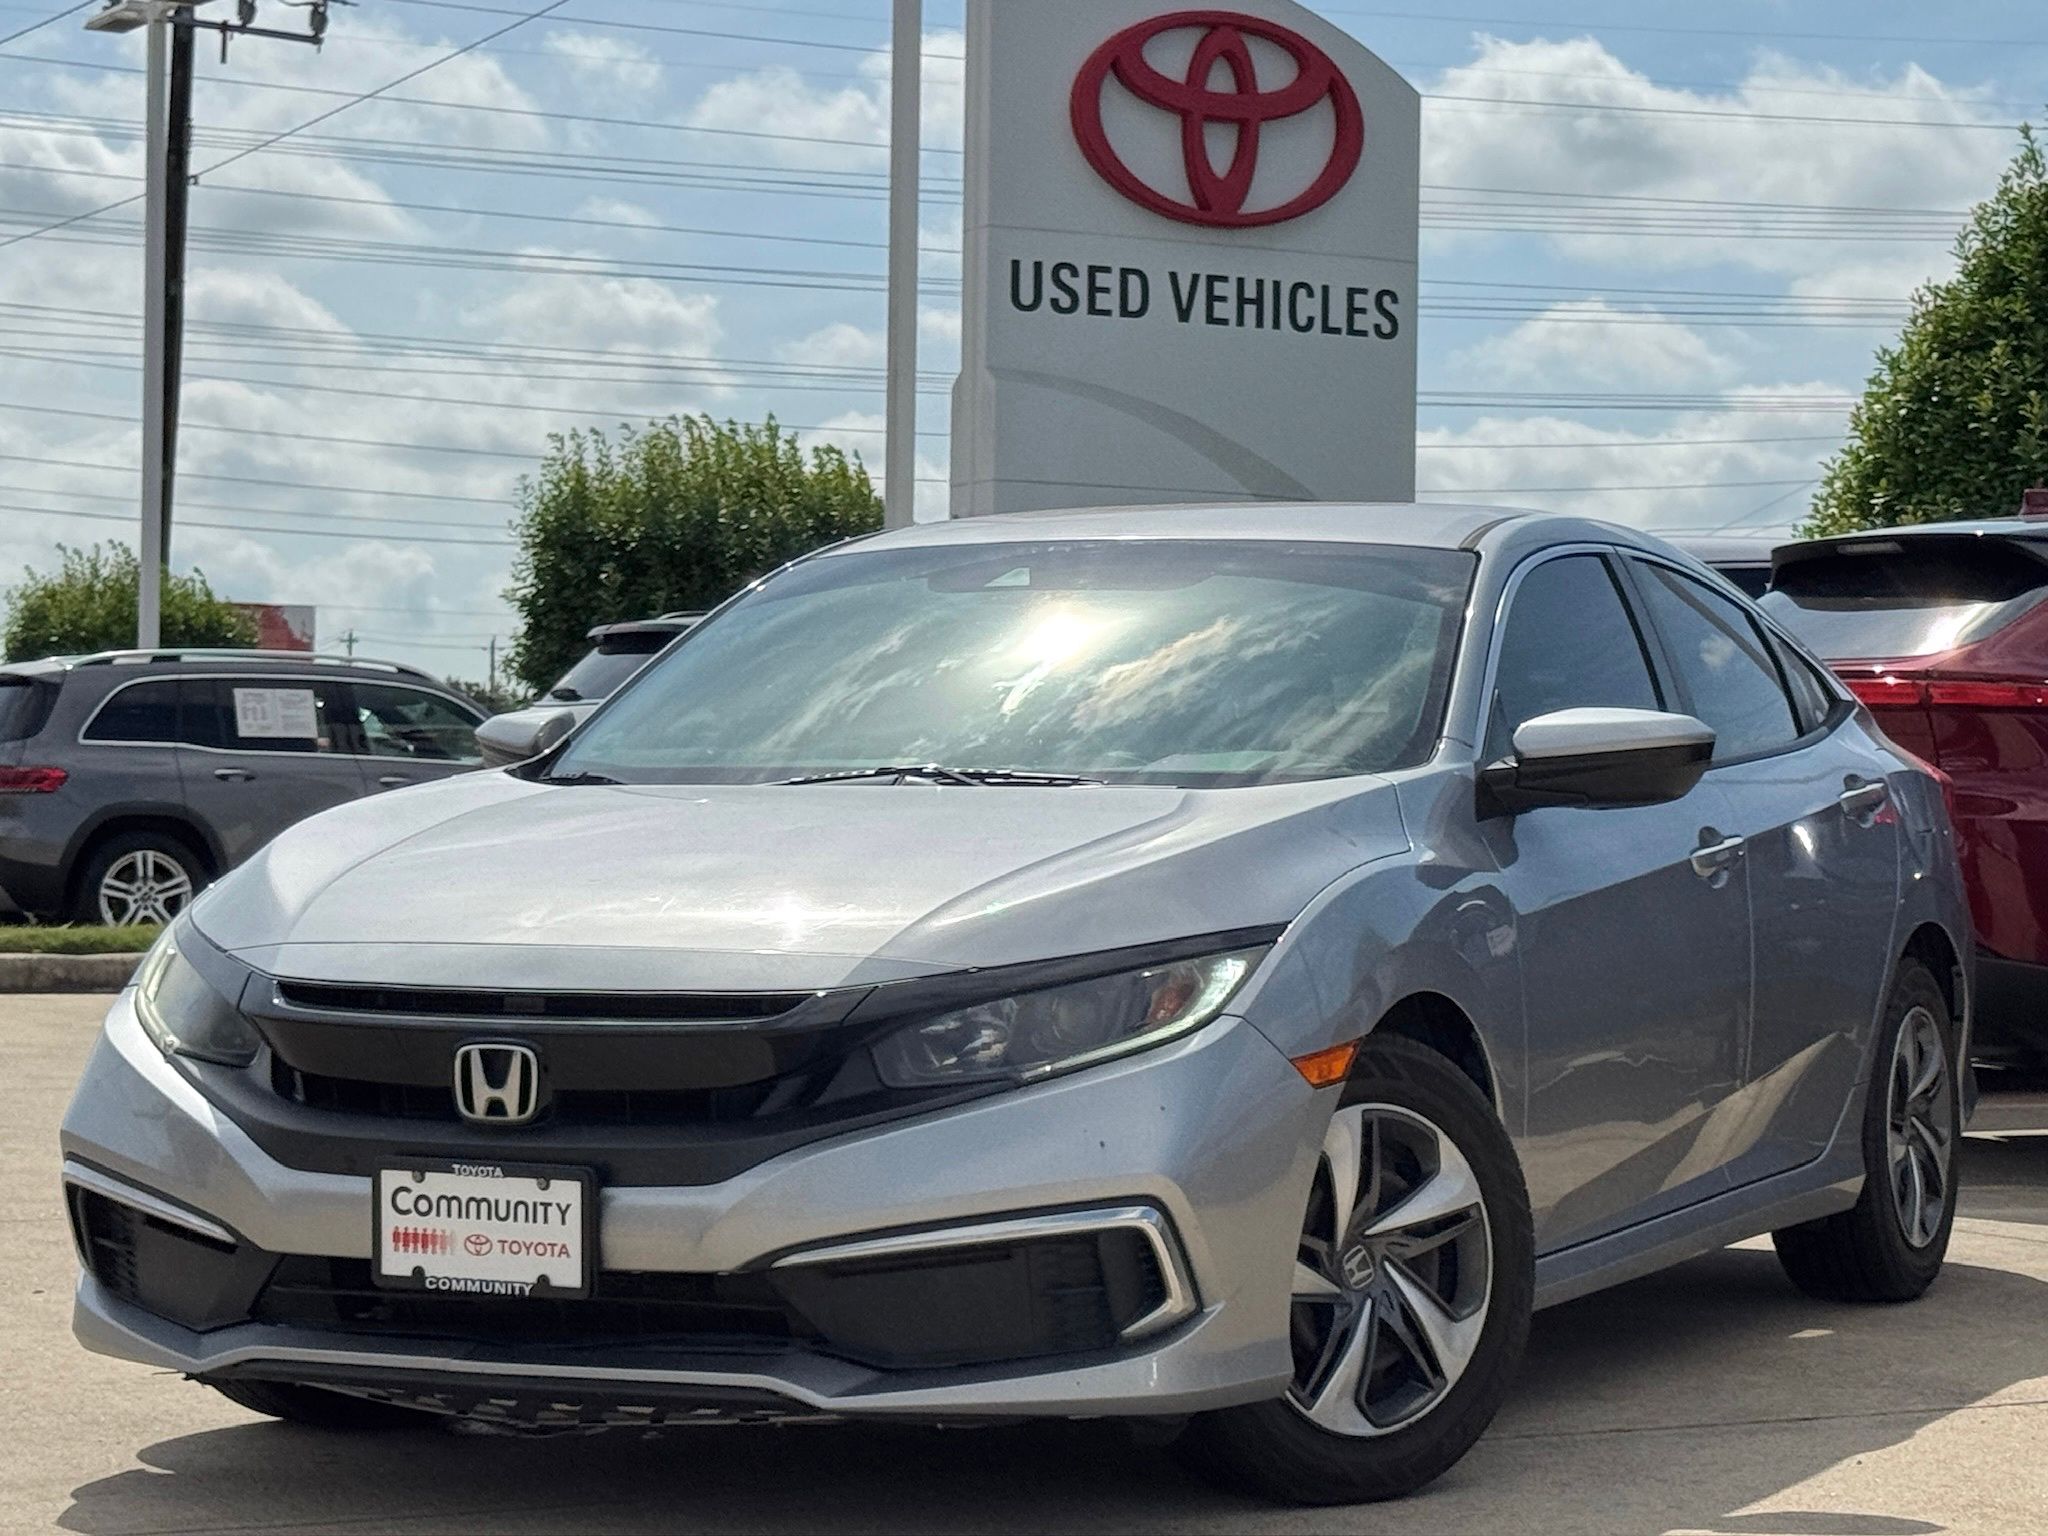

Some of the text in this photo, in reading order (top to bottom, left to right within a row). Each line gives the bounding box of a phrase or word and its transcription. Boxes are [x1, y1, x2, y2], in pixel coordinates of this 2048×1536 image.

[1009, 258, 1400, 340] USED VEHICLES
[452, 1163, 504, 1178] TOYOTA
[497, 1239, 571, 1258] TOYOTA
[425, 1276, 534, 1297] COMMUNITY
